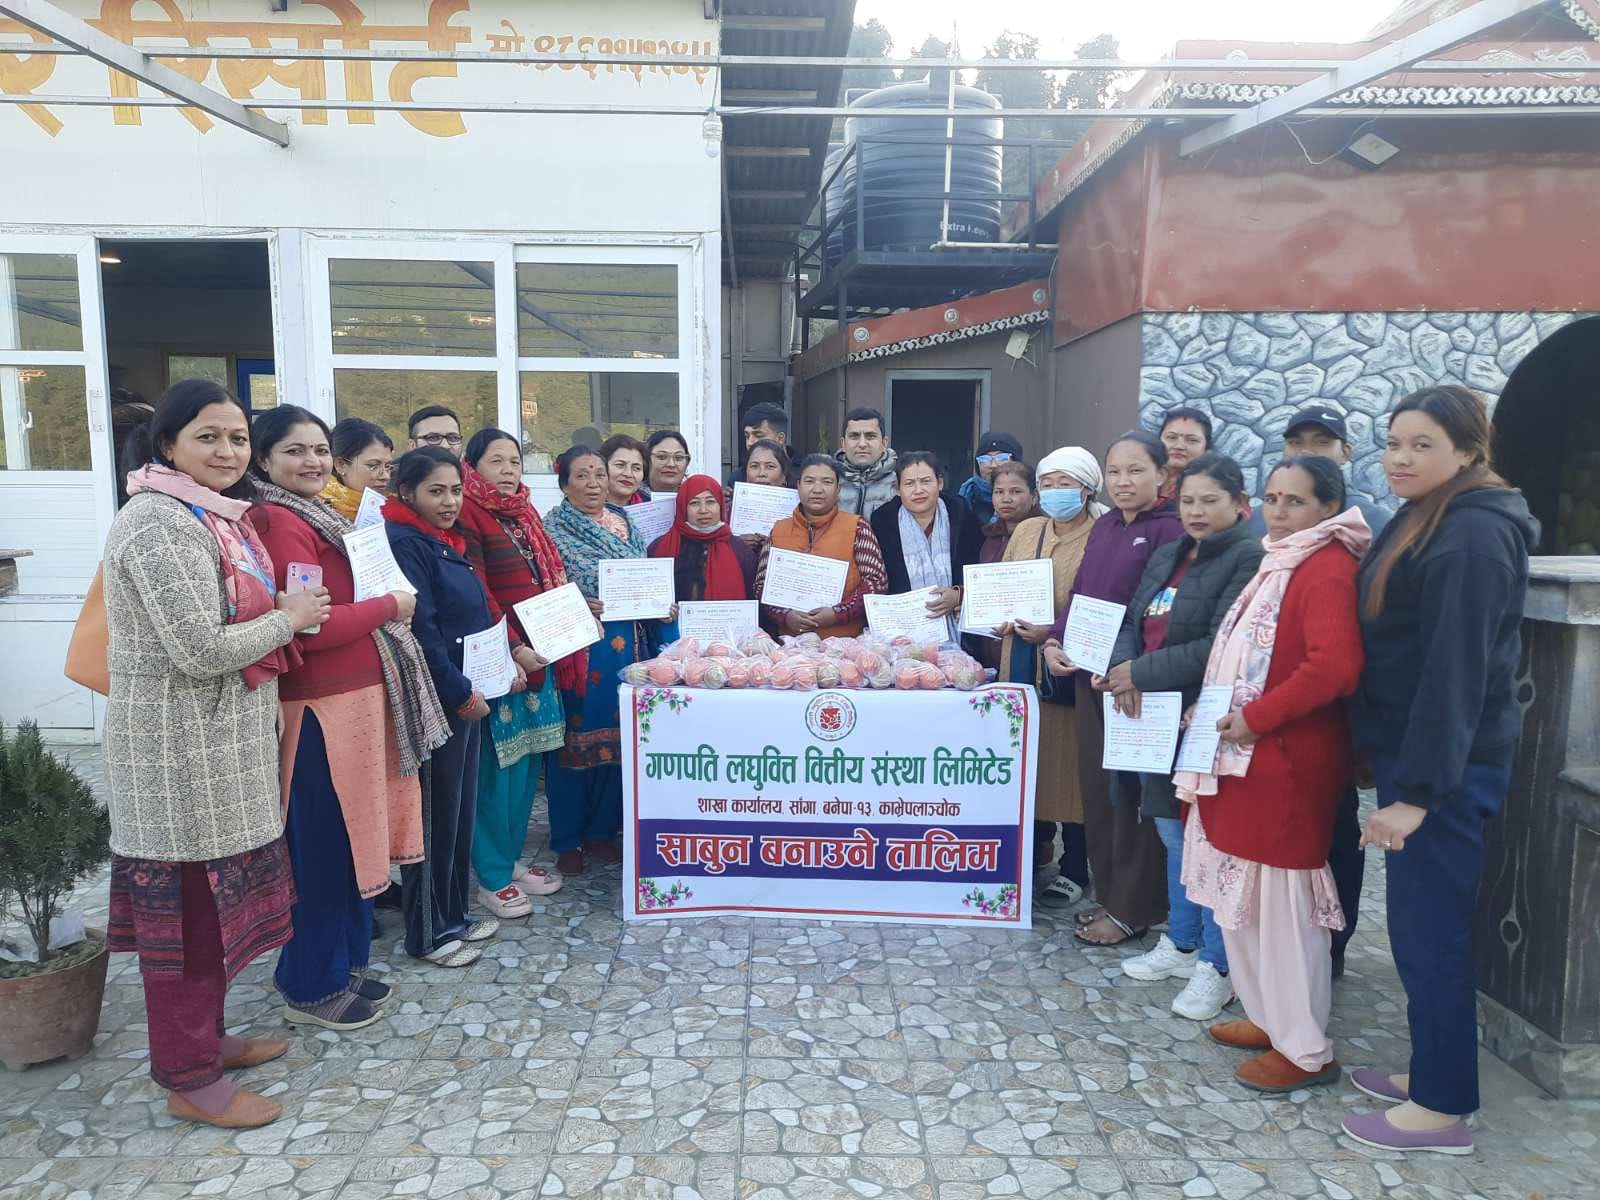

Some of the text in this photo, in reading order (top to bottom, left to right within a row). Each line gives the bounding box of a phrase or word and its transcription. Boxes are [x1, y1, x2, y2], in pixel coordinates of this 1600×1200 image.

[646, 744, 1014, 791] गणपति लघुवित्त वित्तीय संस्था लिमिटेड
[698, 798, 728, 815] शाखा
[657, 827, 1001, 874] साबुन बनाउने तालिम
